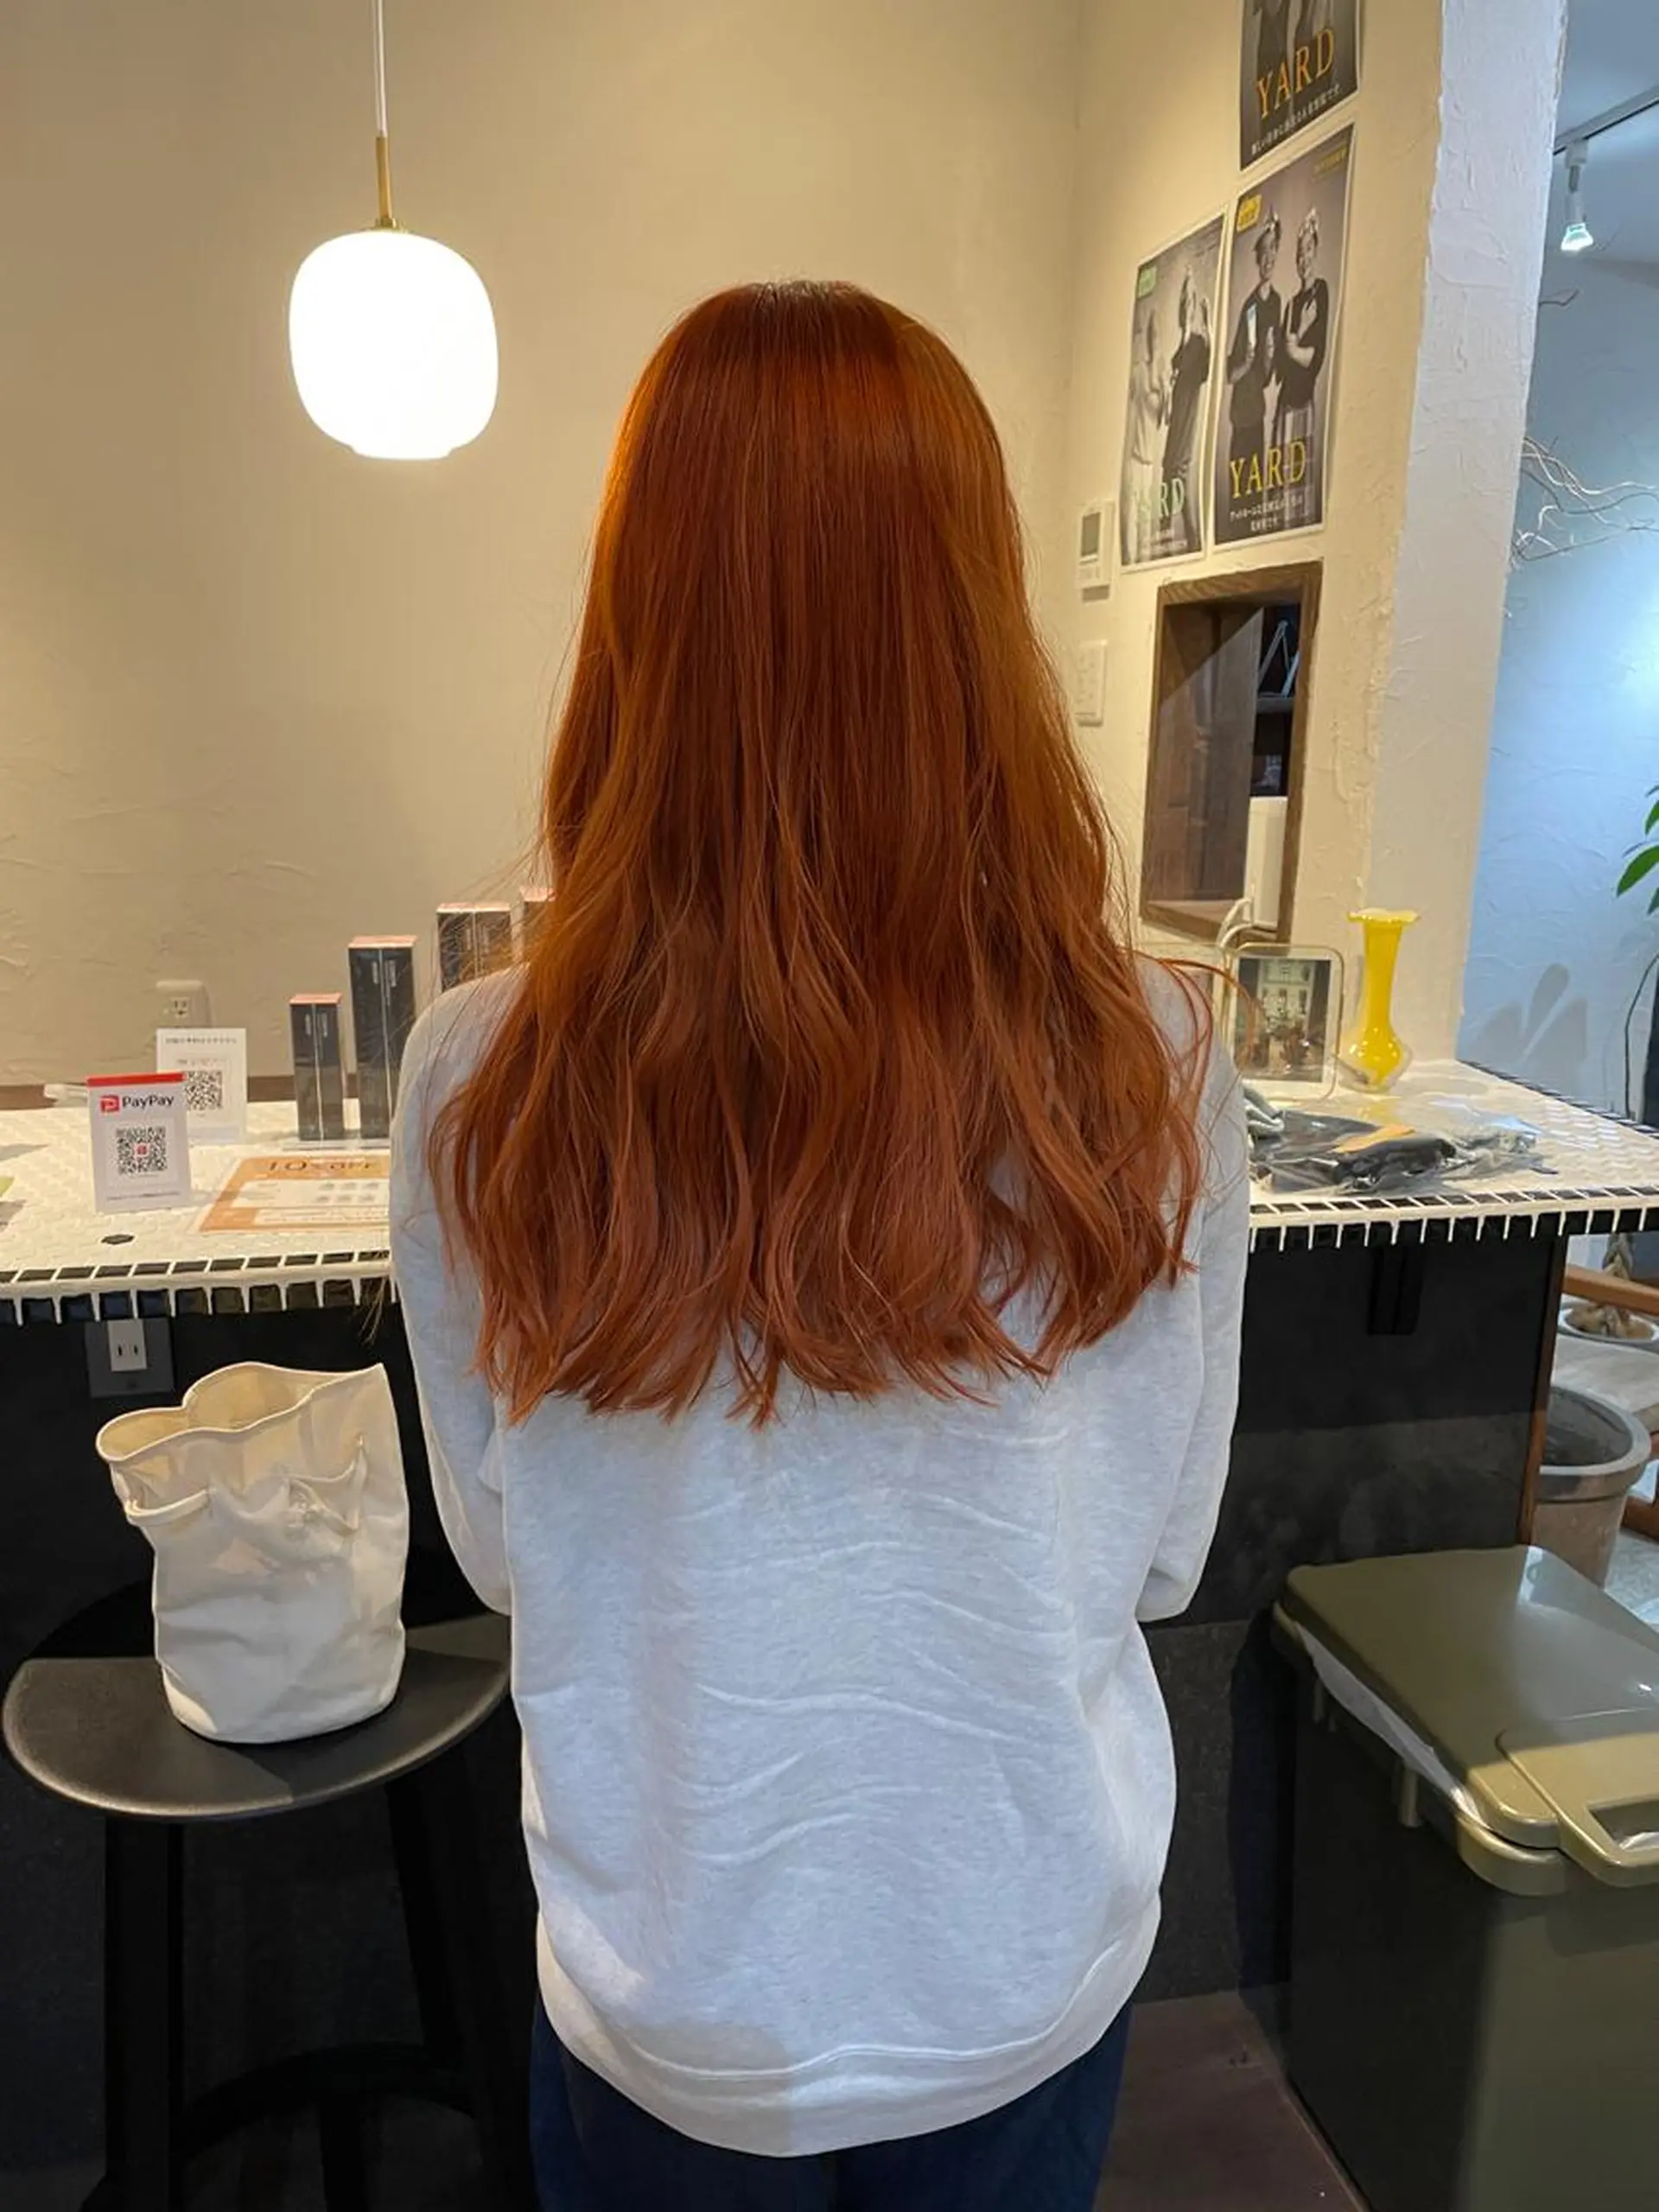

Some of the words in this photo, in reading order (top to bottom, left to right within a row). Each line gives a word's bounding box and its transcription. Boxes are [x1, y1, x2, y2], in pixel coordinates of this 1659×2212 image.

[1256, 28, 1335, 119] YARD
[1230, 441, 1307, 499] YARD
[122, 1095, 175, 1109] PayPay
